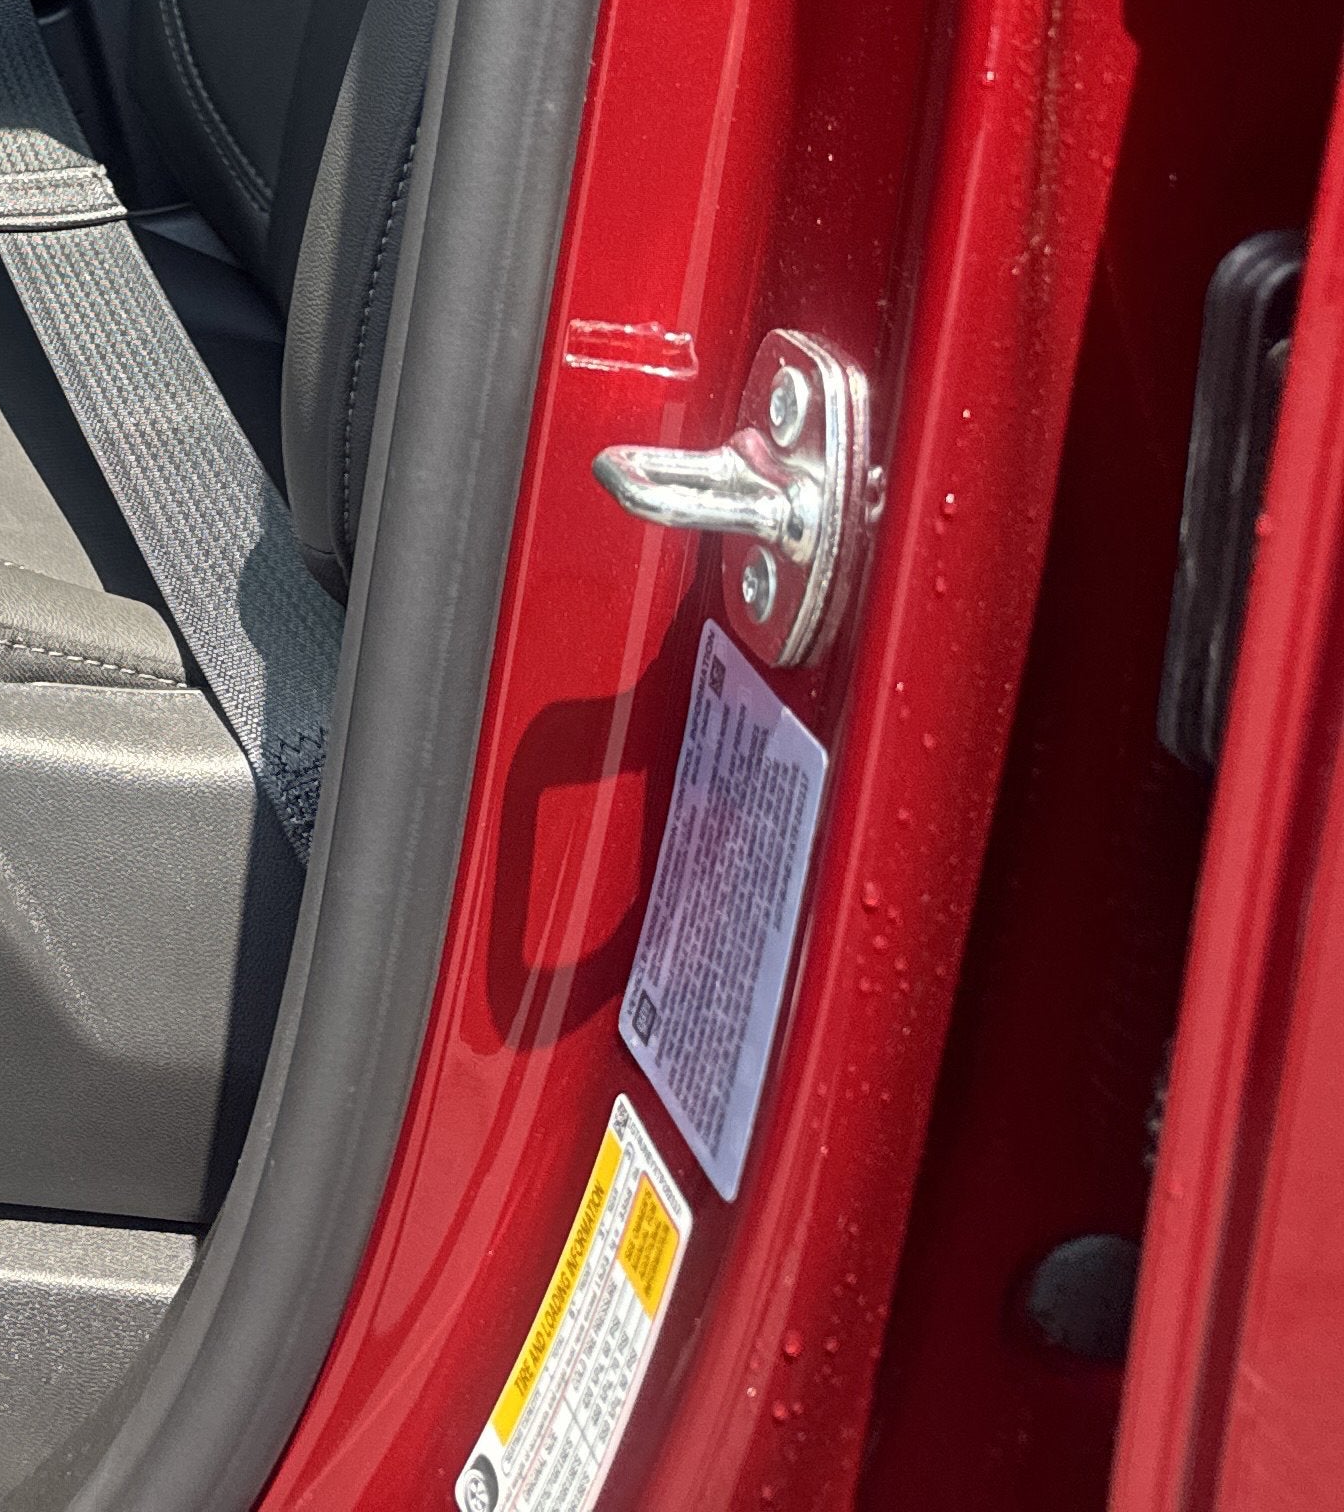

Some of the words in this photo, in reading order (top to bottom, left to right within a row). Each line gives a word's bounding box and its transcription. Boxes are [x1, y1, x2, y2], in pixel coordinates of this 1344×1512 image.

[690, 629, 715, 740] INFORMATION
[514, 1360, 534, 1397] TIRE
[528, 1330, 547, 1368] AND
[541, 1272, 571, 1338] LOADING
[565, 1180, 605, 1280] INFORMATION
